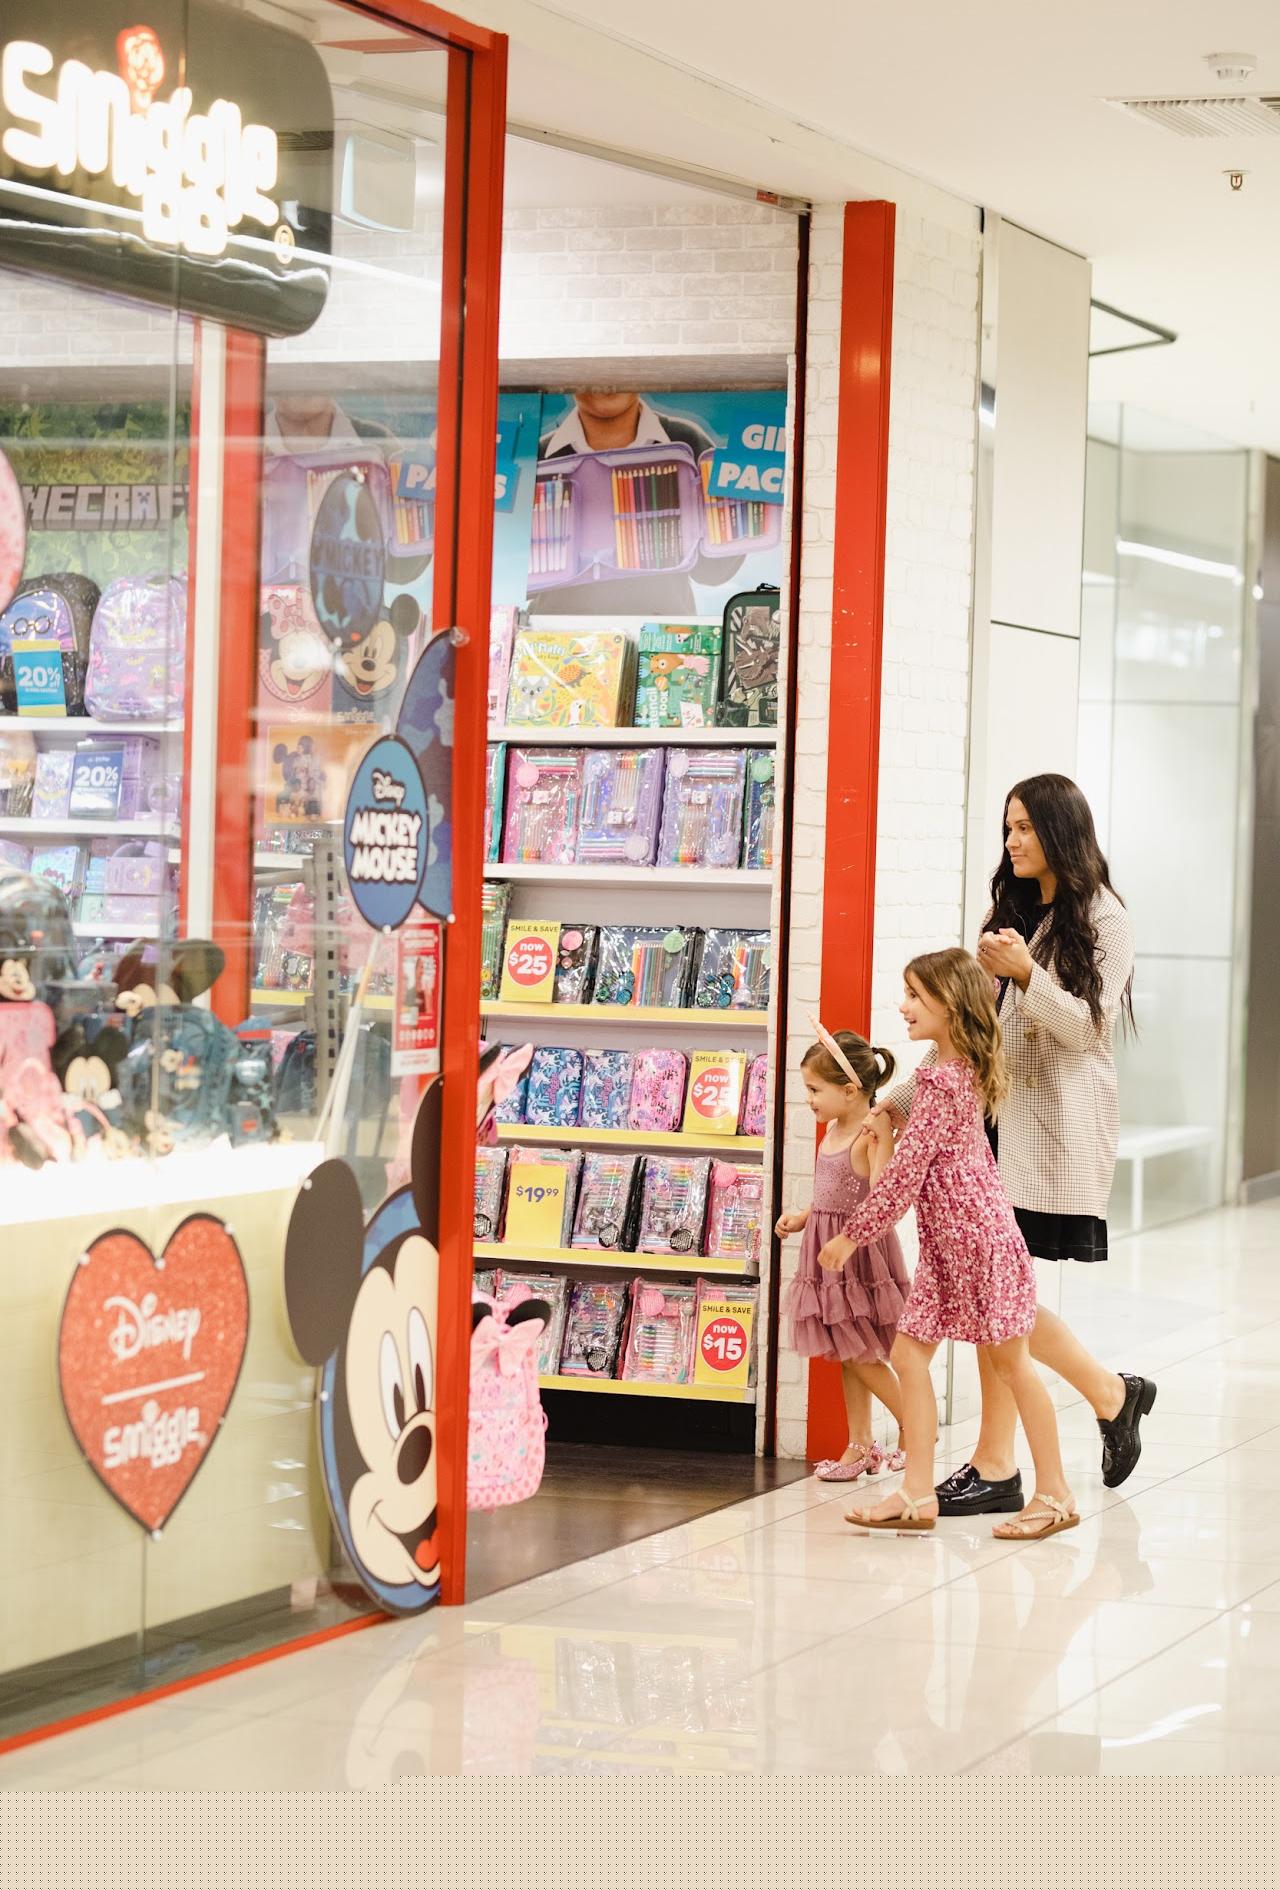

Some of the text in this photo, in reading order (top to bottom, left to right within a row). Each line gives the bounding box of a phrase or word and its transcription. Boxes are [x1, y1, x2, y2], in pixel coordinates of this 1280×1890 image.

[717, 462, 785, 494] PAC
[18, 665, 61, 688] 20%
[75, 765, 118, 787] 20%
[349, 809, 422, 848] MICKEY
[350, 846, 418, 882] MOUSE
[520, 943, 545, 952] now
[509, 951, 548, 976] $25
[695, 1055, 718, 1063] SMILE
[704, 1074, 729, 1083] now
[702, 1305, 724, 1313] SMILE
[712, 1324, 738, 1334] now
[702, 1333, 743, 1361] $15
